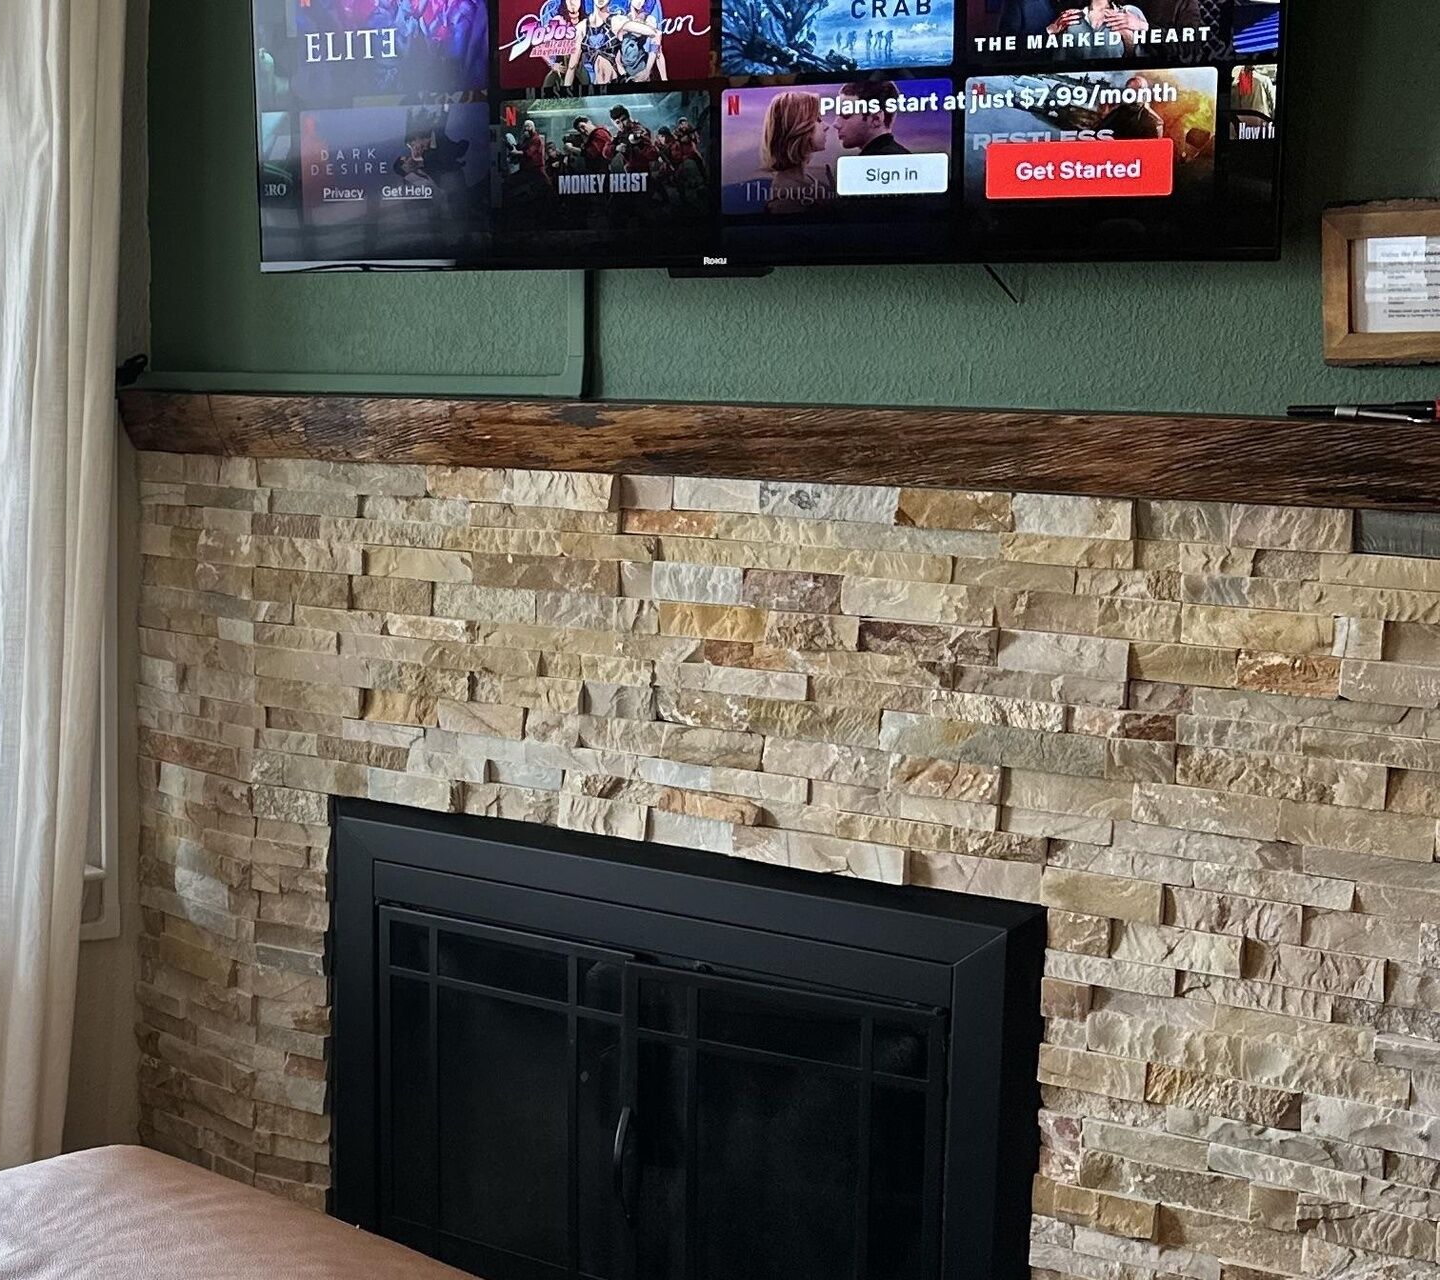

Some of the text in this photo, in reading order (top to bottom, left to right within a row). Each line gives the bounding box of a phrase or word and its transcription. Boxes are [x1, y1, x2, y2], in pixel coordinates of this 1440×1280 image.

[974, 27, 1211, 52] THE MARKED HEART
[820, 82, 1178, 116] Plans start at just $7.99/month
[1238, 122, 1261, 140] How
[321, 148, 376, 161] DARK
[311, 162, 388, 176] DESIRE
[866, 167, 918, 185] Sign in
[1015, 159, 1142, 181] Get Started
[382, 185, 433, 198] Get Help
[558, 172, 649, 195] MONEY HEIST
[742, 179, 826, 206] Through
[323, 187, 364, 199] Privacy
